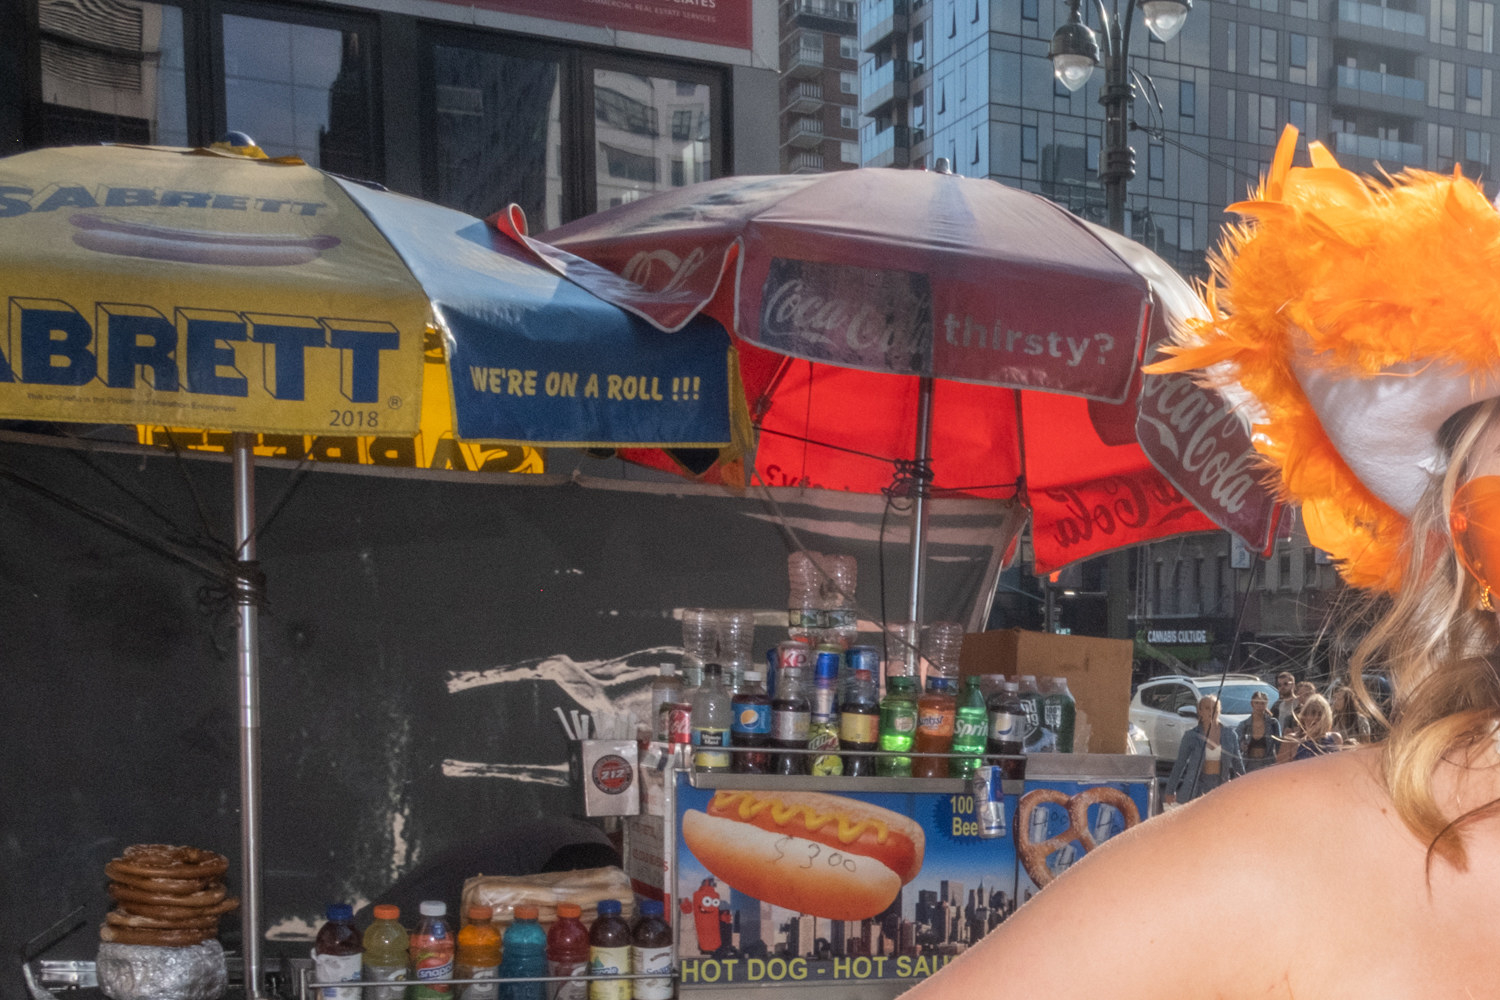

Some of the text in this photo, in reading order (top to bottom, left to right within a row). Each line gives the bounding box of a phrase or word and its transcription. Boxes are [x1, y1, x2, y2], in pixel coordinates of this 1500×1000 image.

[943, 312, 1116, 367] thirsty?
[0, 296, 400, 404] BRETT
[469, 364, 701, 401] WE'RE ON A ROLL !!!
[329, 409, 379, 428] 2018
[1147, 630, 1207, 643] CANNABIS CULTURE
[954, 719, 988, 738] Sprit
[949, 795, 974, 815] 100
[952, 817, 979, 837] Bee
[681, 959, 739, 983] HOT
[746, 957, 809, 982] DOG
[833, 955, 888, 979] HOT
[896, 954, 957, 979] SAU
